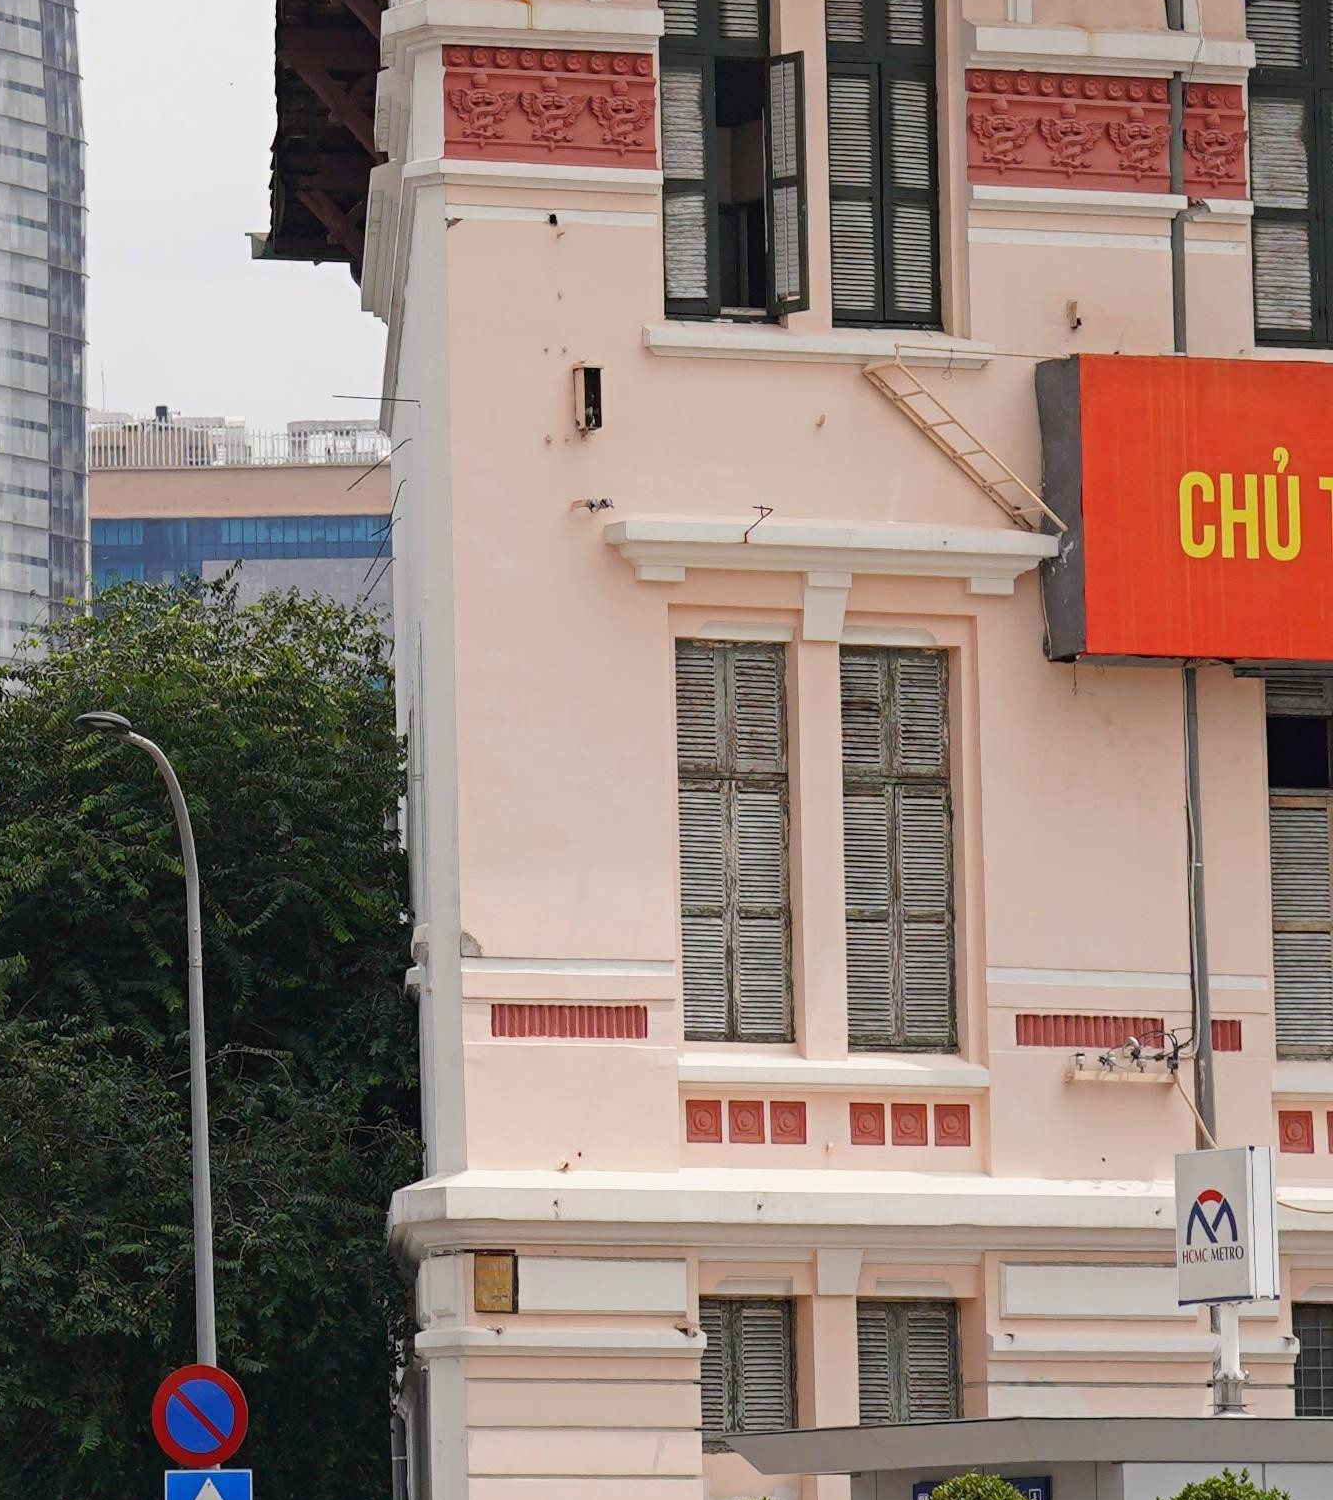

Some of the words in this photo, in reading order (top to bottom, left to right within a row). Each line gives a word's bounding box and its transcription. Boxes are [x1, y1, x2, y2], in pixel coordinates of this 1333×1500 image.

[1179, 446, 1302, 561] CHỦ
[1182, 1248, 1208, 1264] HCMC
[1211, 1245, 1244, 1262] METRO
